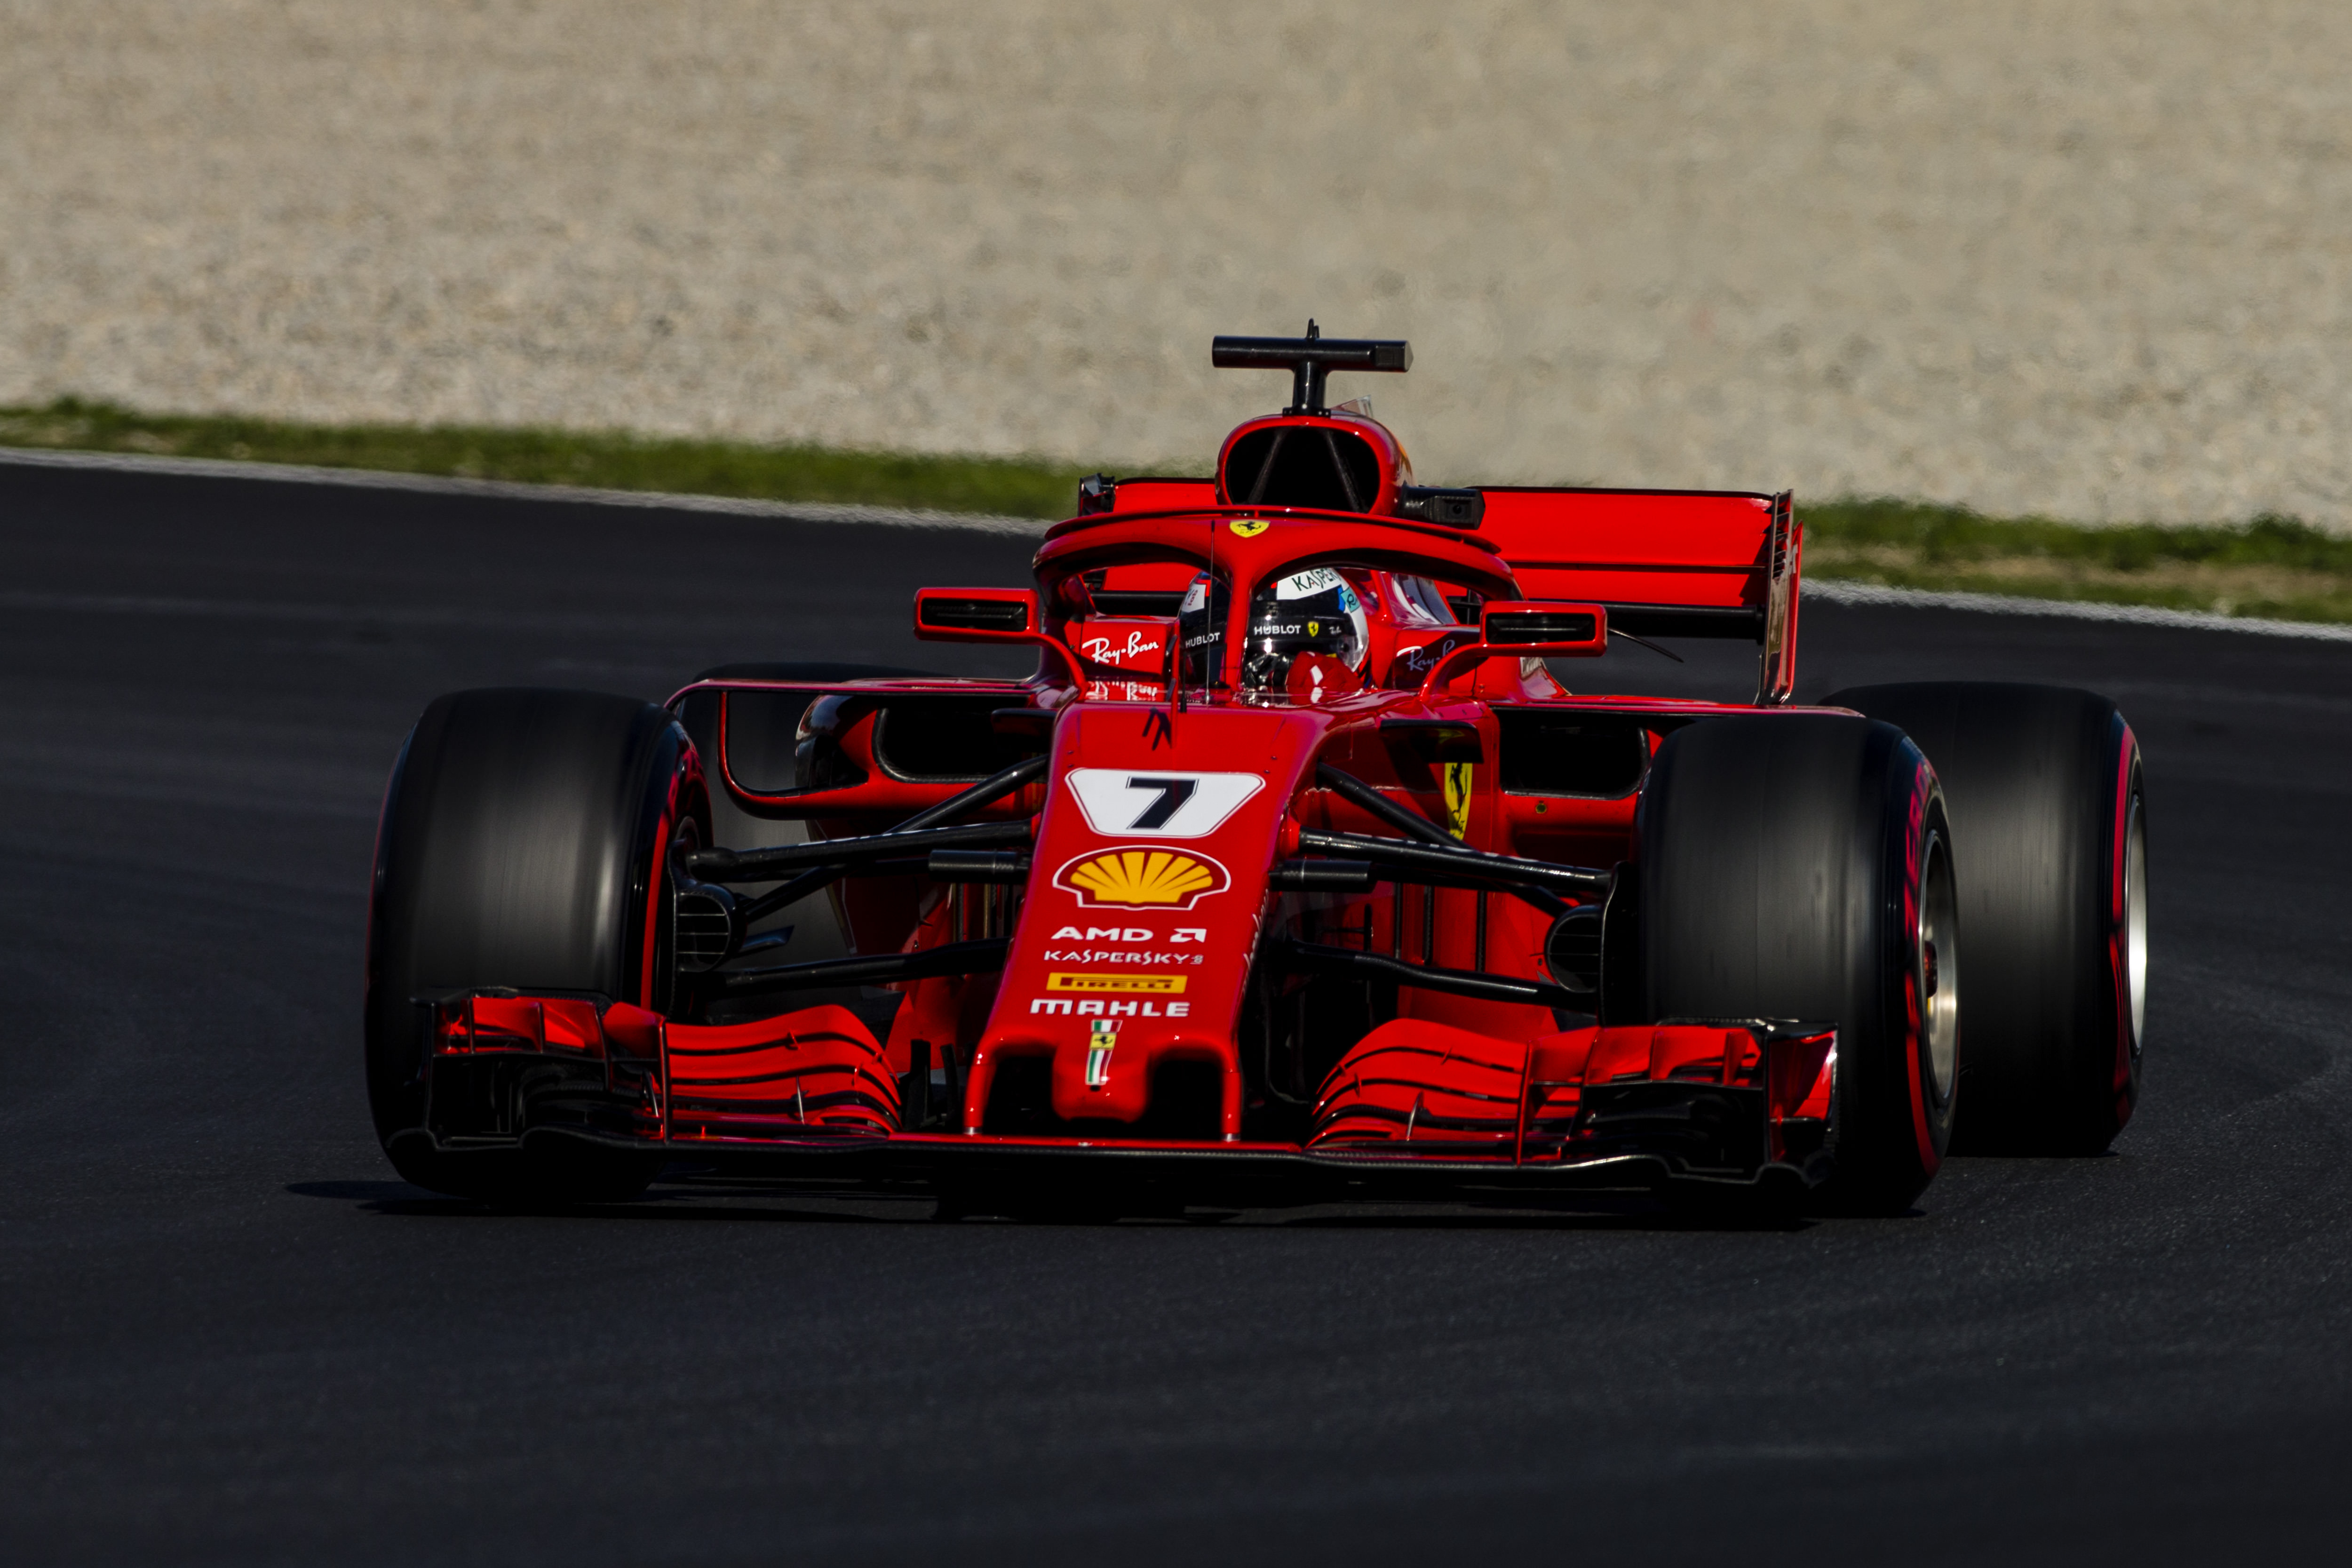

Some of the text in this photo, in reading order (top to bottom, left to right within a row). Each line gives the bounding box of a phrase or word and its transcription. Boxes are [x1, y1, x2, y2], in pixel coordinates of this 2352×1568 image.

[1254, 625, 1301, 635] HUBLOT
[1082, 631, 1159, 665] Ray-Ban
[1185, 632, 1220, 648] HUBLOT
[1397, 640, 1455, 671] Ray-B
[1126, 776, 1199, 830] 7
[1051, 926, 1153, 941] AMD
[1043, 949, 1190, 965] KASPERSKY
[1030, 998, 1191, 1017] MAHLE
